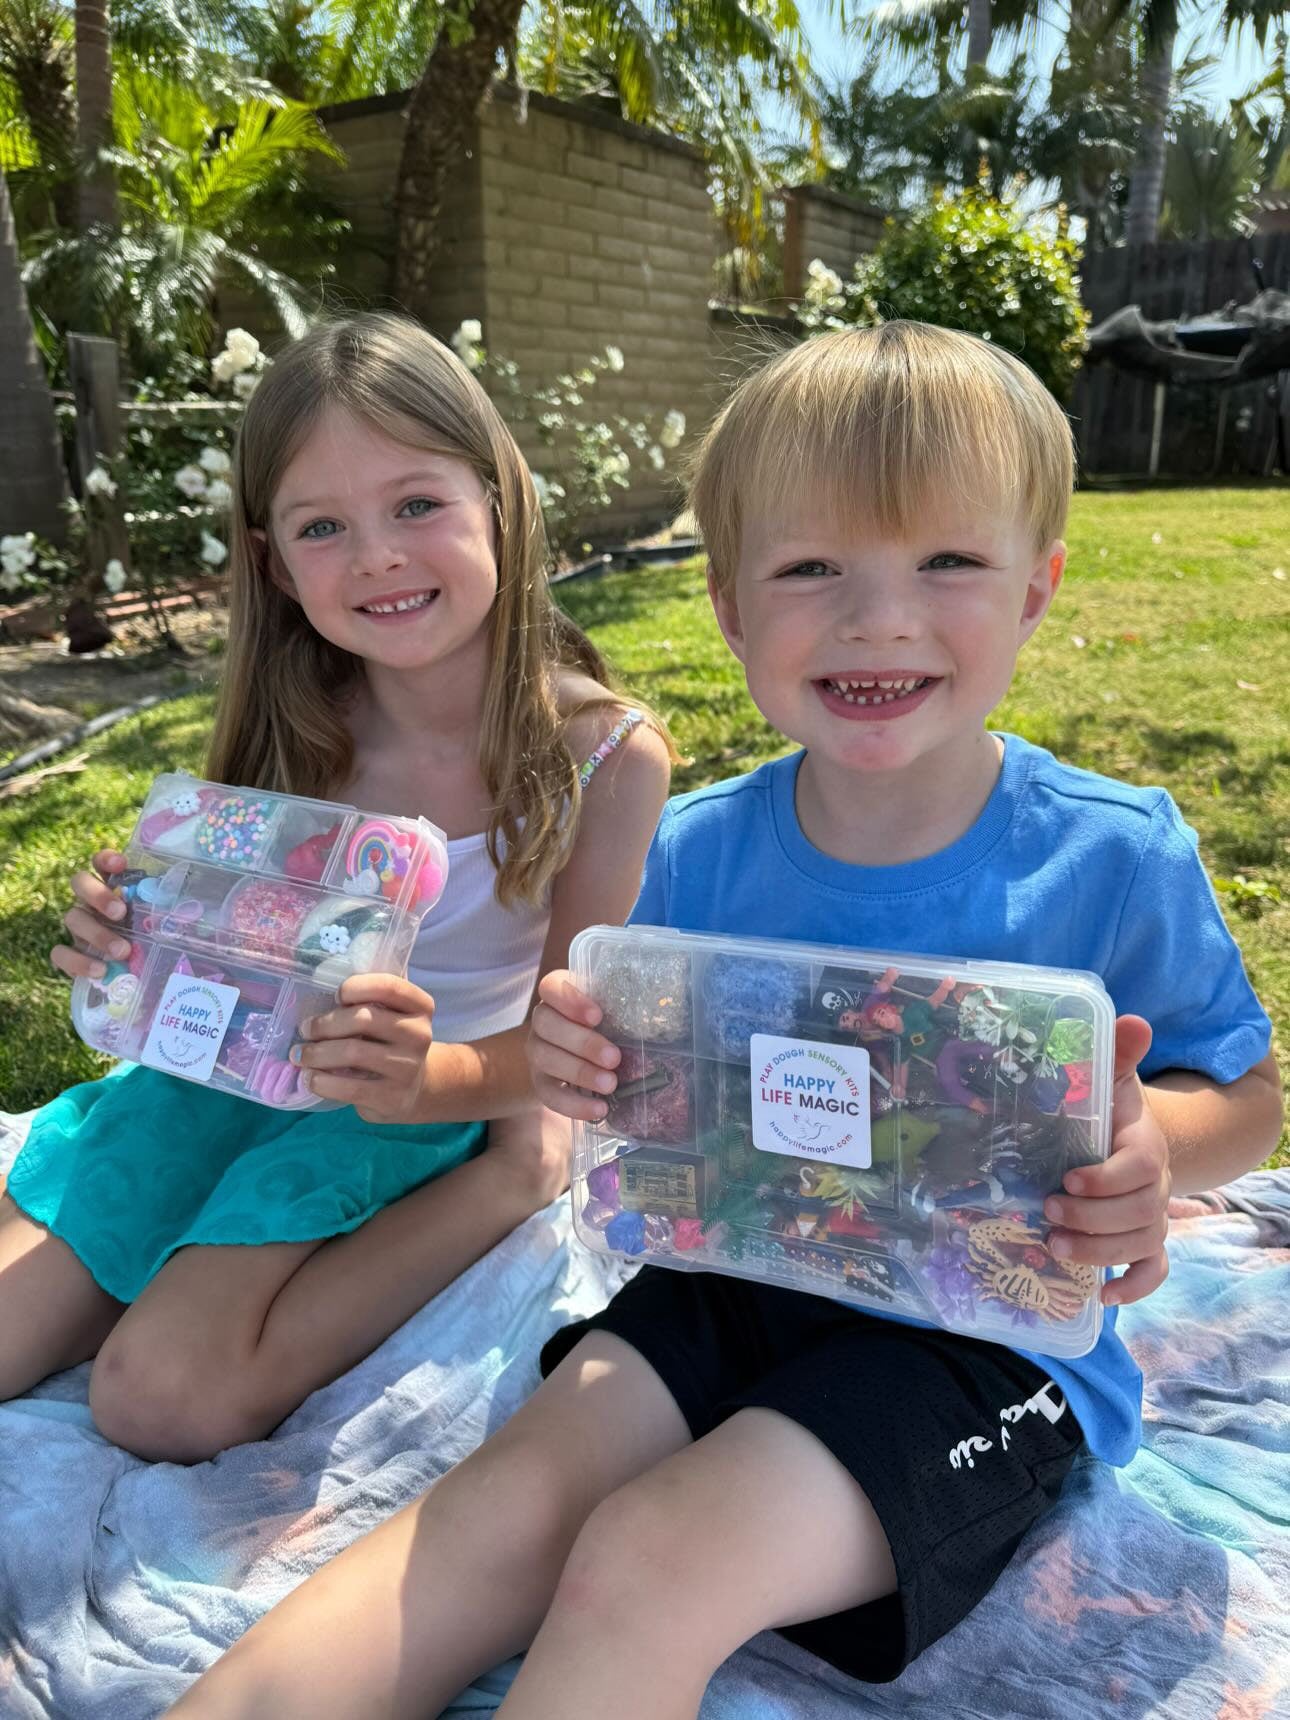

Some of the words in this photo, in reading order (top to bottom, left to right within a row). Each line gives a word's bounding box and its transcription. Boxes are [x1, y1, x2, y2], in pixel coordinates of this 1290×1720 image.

[178, 1004, 211, 1021] HAPPY
[160, 1014, 182, 1029] LIFE
[182, 1020, 220, 1039] MAGIC
[760, 1063, 774, 1083] PLAY
[772, 1049, 805, 1066] DOUGH
[807, 1049, 847, 1077] SENSORY
[845, 1077, 859, 1097] KITS
[784, 1073, 835, 1094] HAPPY
[761, 1088, 792, 1105] LIFE
[799, 1093, 860, 1116] MAGIC
[769, 1121, 853, 1154] happylifemagic.com
